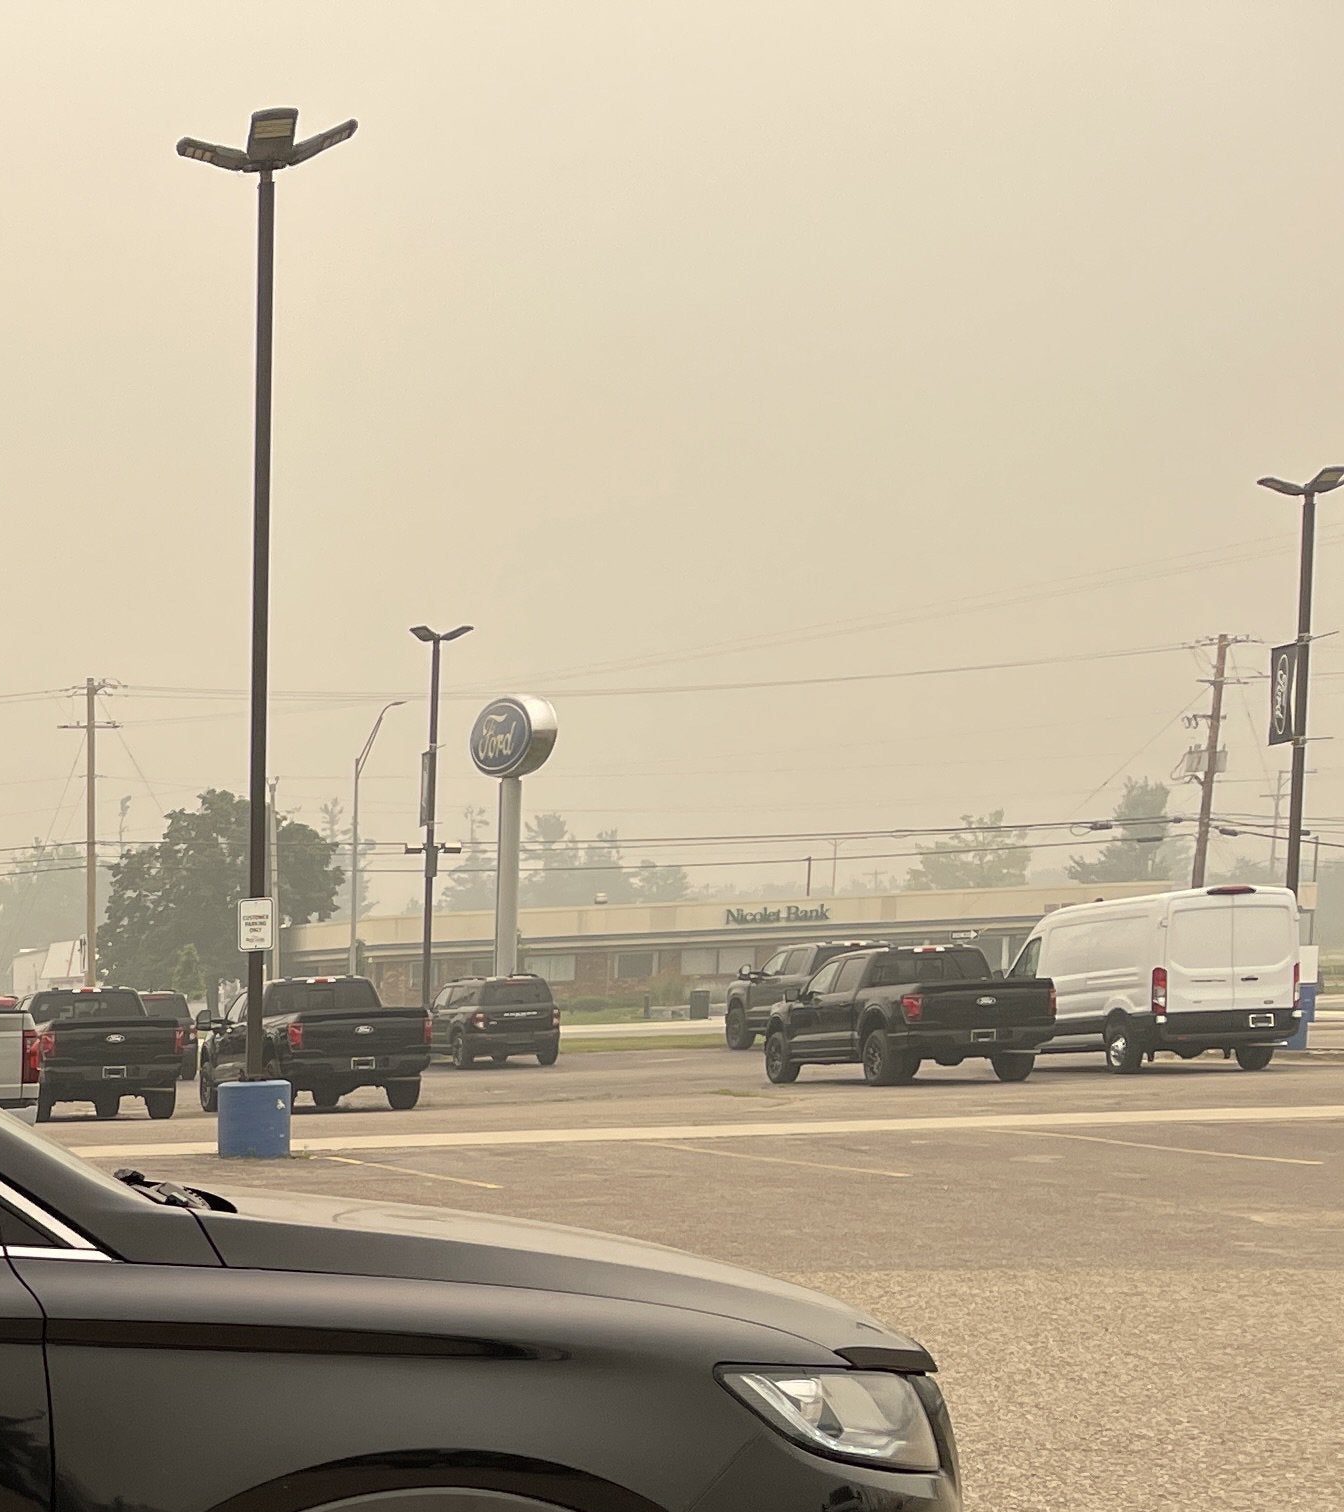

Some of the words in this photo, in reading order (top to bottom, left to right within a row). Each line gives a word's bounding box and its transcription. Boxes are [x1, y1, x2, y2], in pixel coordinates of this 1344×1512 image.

[1275, 669, 1287, 719] Ford
[478, 713, 517, 760] Ford
[725, 906, 781, 925] Nicolet
[786, 903, 831, 922] Bank
